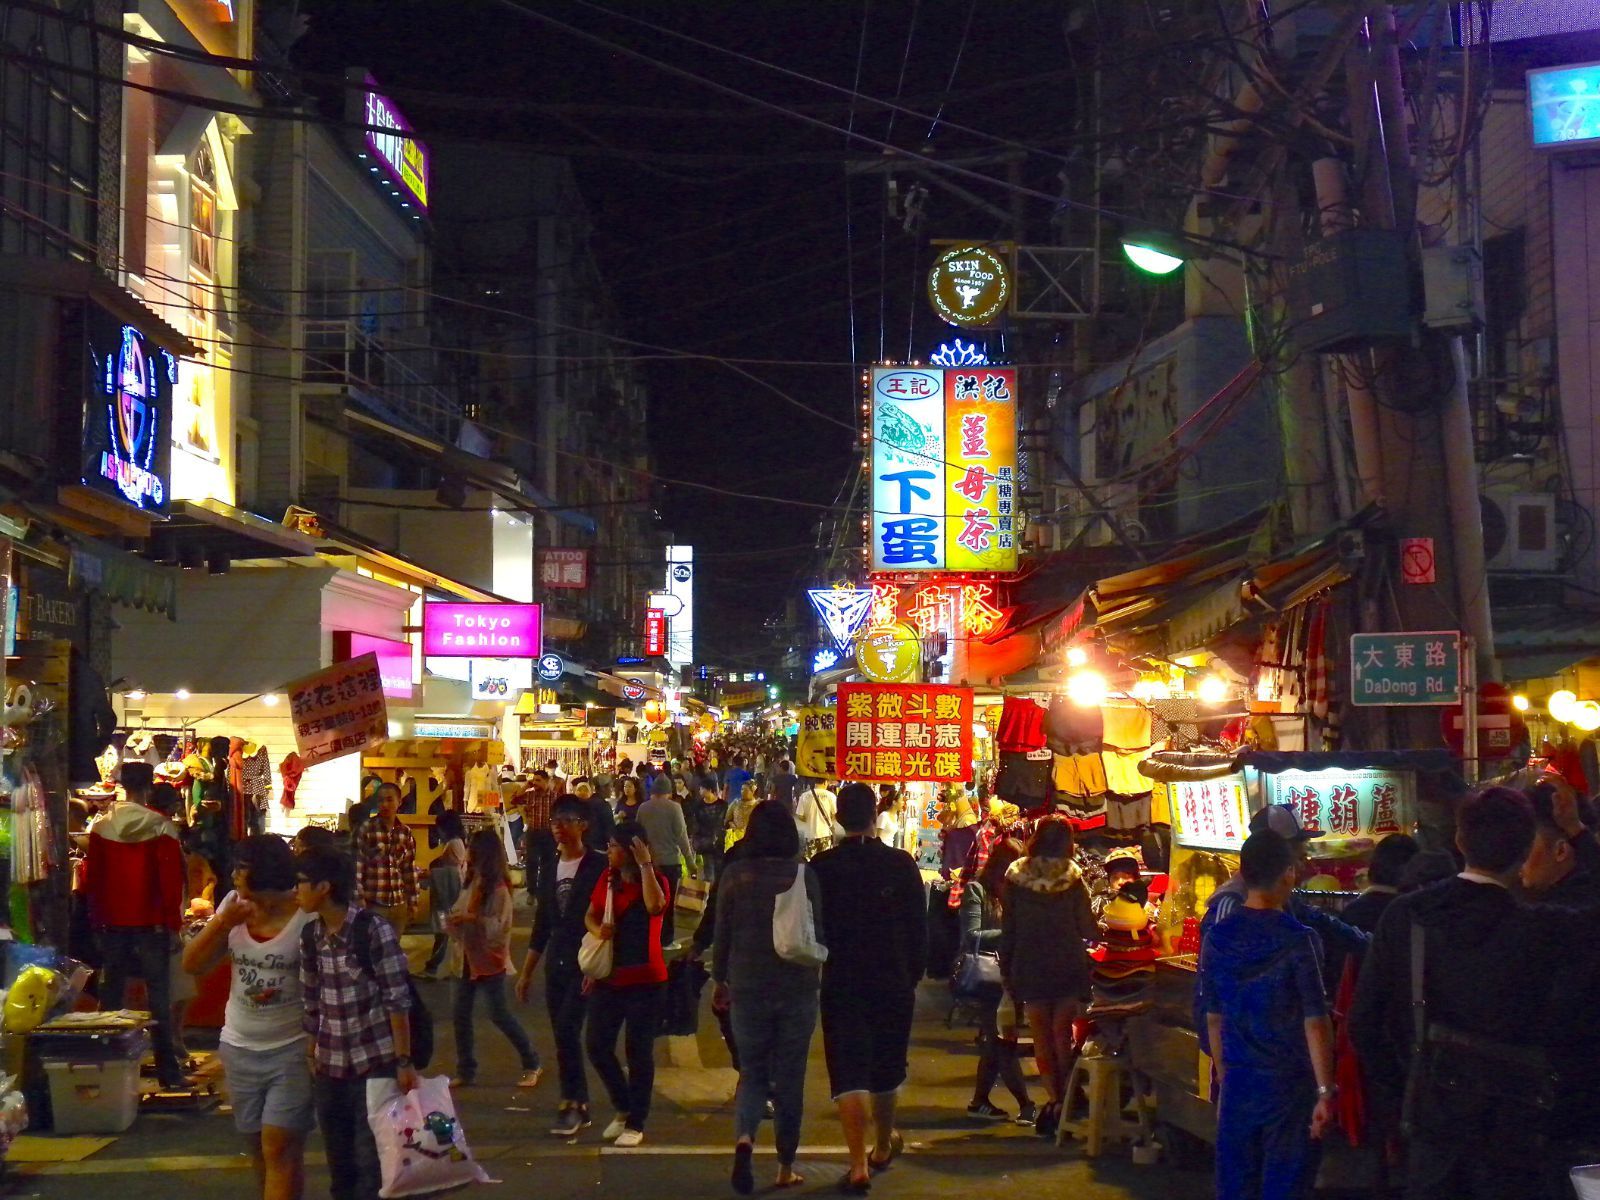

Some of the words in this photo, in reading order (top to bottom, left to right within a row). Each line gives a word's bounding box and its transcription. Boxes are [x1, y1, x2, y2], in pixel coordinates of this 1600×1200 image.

[948, 260, 980, 272] SKIN
[969, 270, 994, 280] FOOD
[886, 377, 931, 395] 王記
[955, 374, 1011, 400] 洪記
[954, 414, 996, 552] 薑母茶
[879, 470, 939, 564] 下蛋
[453, 614, 511, 629] Tokyo
[442, 632, 521, 647] Fashion
[1362, 640, 1447, 669] 大東路
[1364, 678, 1417, 696] DaDong
[846, 692, 962, 720] 紫微斗數
[846, 722, 961, 749] 開運點痣
[845, 751, 961, 778] 知識光碟
[1288, 784, 1401, 836] 糖葫蘆
